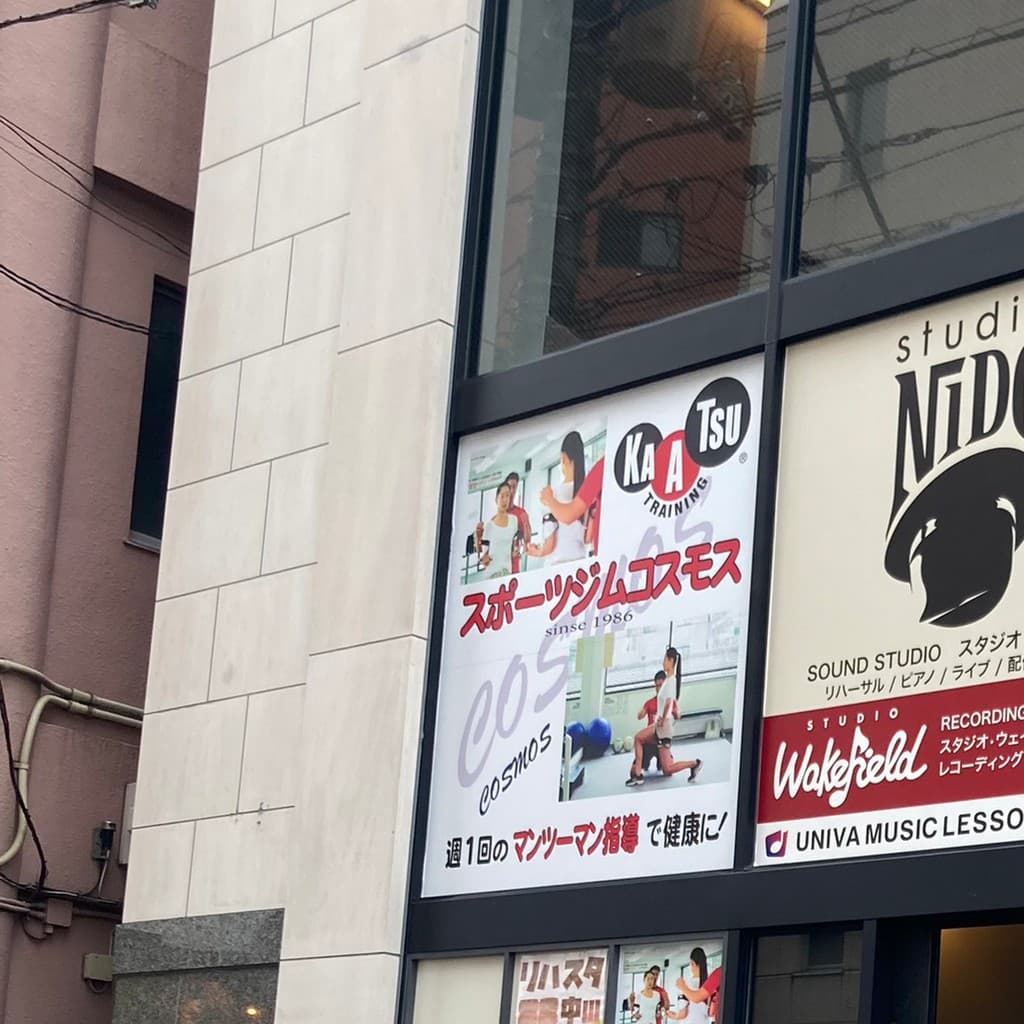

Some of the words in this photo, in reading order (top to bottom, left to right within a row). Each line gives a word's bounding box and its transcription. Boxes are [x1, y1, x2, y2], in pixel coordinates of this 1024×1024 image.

[643, 477, 708, 519] TRAINING
[459, 538, 742, 638] スポーツジムコスモス
[544, 622, 587, 638] sinse
[594, 609, 634, 628] 1986
[807, 655, 869, 682] SOUND
[874, 644, 942, 671] STUDIO
[806, 707, 898, 731] STUDIO
[479, 723, 552, 816] COSMOS
[773, 724, 928, 808] Wakefield
[796, 826, 860, 851] UNIVA
[865, 817, 938, 845] MUSIC
[520, 957, 605, 992] リハスタ
